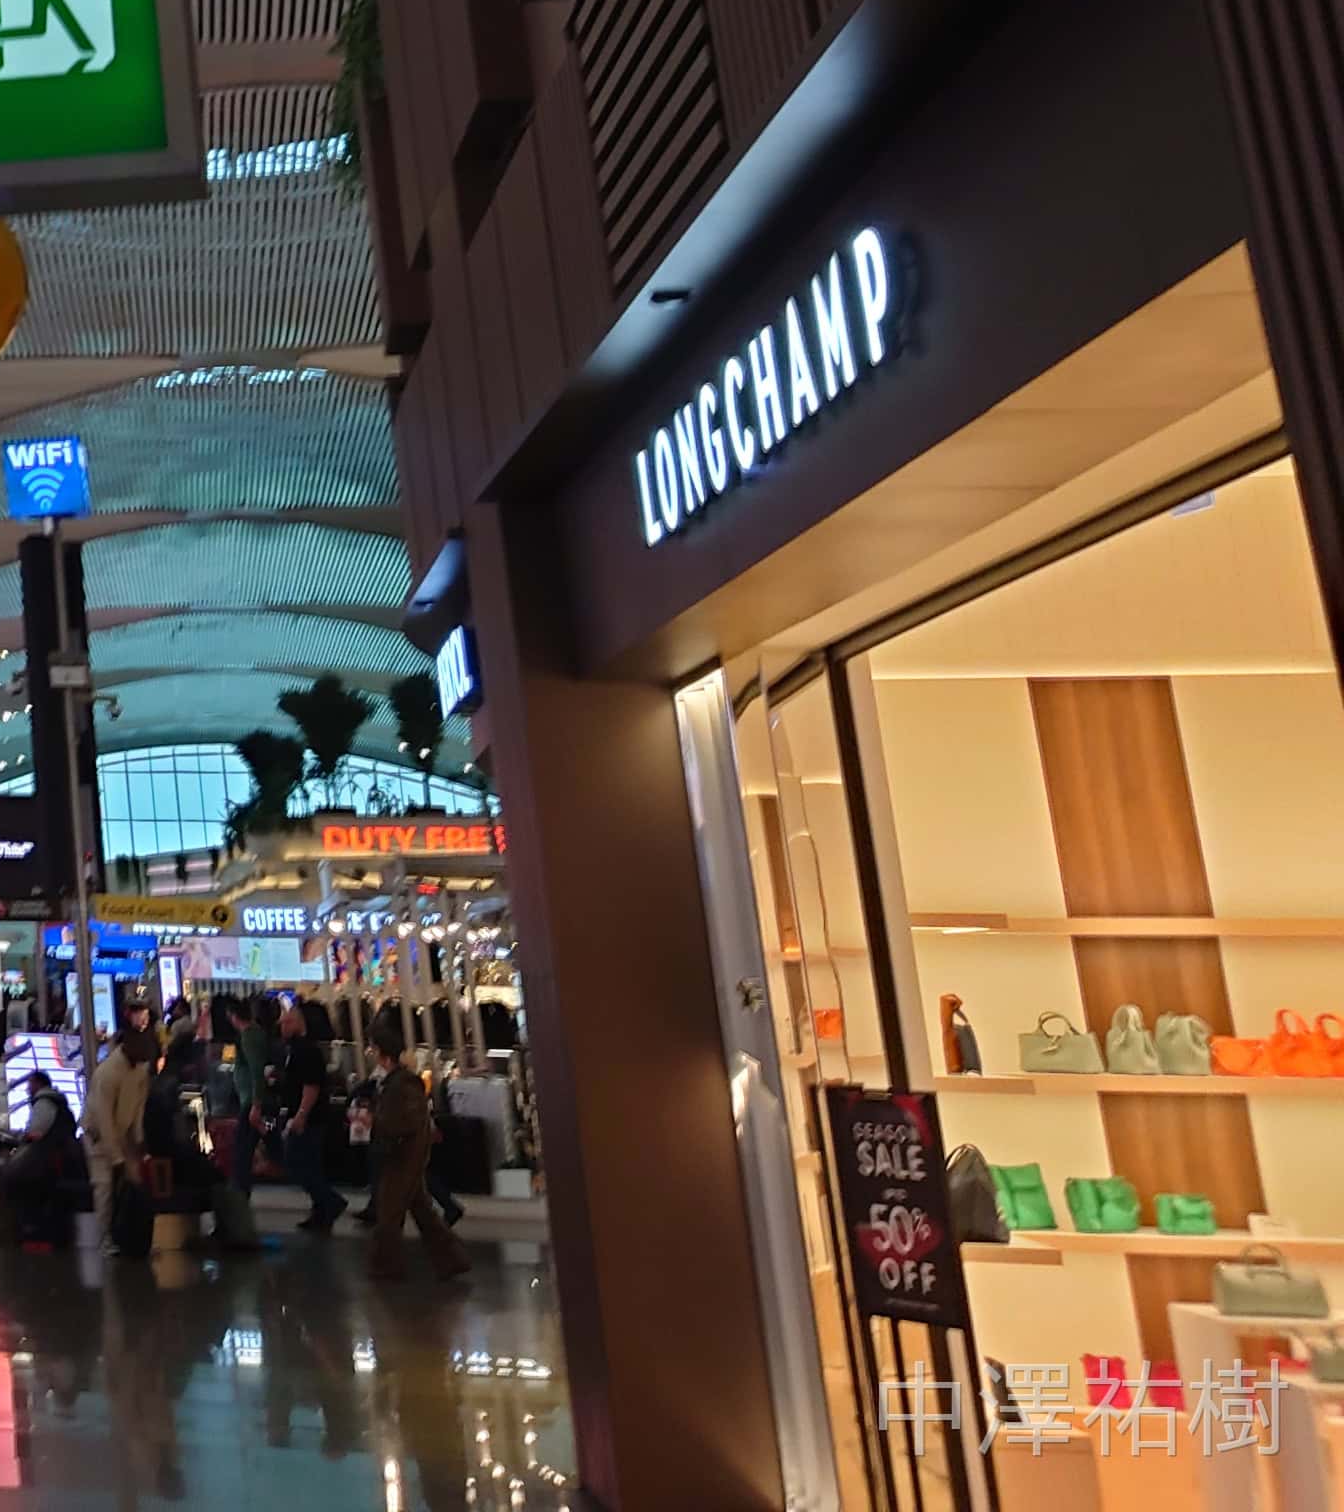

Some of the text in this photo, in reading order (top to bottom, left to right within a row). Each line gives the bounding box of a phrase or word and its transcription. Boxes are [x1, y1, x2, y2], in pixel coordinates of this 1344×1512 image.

[635, 226, 892, 547] LONGCHAMP
[6, 439, 72, 468] WiFi
[323, 825, 416, 852] DUTY
[243, 907, 306, 932] COFFEE
[857, 1140, 927, 1181] SALE
[869, 1203, 931, 1255] 50%
[879, 1257, 936, 1295] OFF
